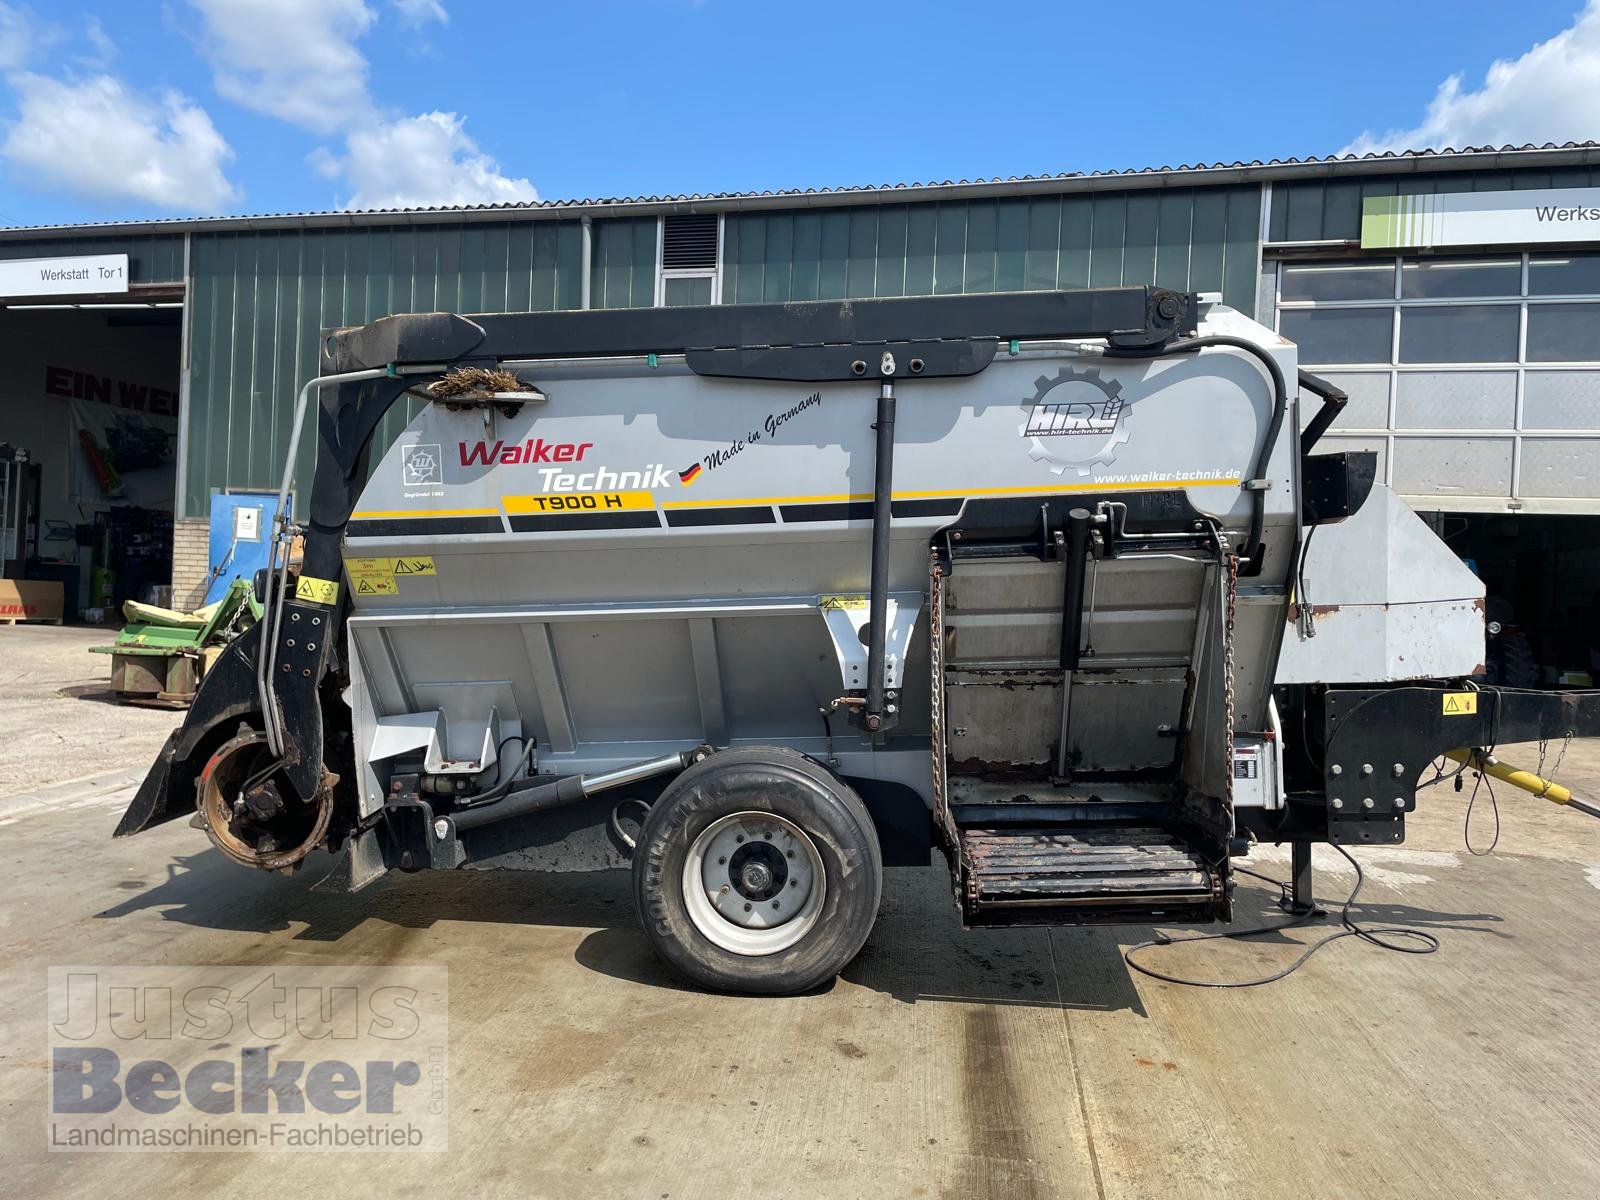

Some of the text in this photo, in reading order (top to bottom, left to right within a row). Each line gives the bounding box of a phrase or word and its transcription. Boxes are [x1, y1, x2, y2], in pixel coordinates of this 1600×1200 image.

[1535, 205, 1600, 221] Werks
[40, 267, 123, 281] Werkstatt Tor 1
[46, 366, 112, 404] EIN
[704, 392, 822, 470] Made in Germany
[1026, 427, 1113, 436] www.hirl-technik.de
[459, 438, 594, 467] Walker
[538, 464, 673, 492] Technik
[1094, 469, 1241, 484] www.walker-technik.de
[533, 494, 623, 511] T900 H
